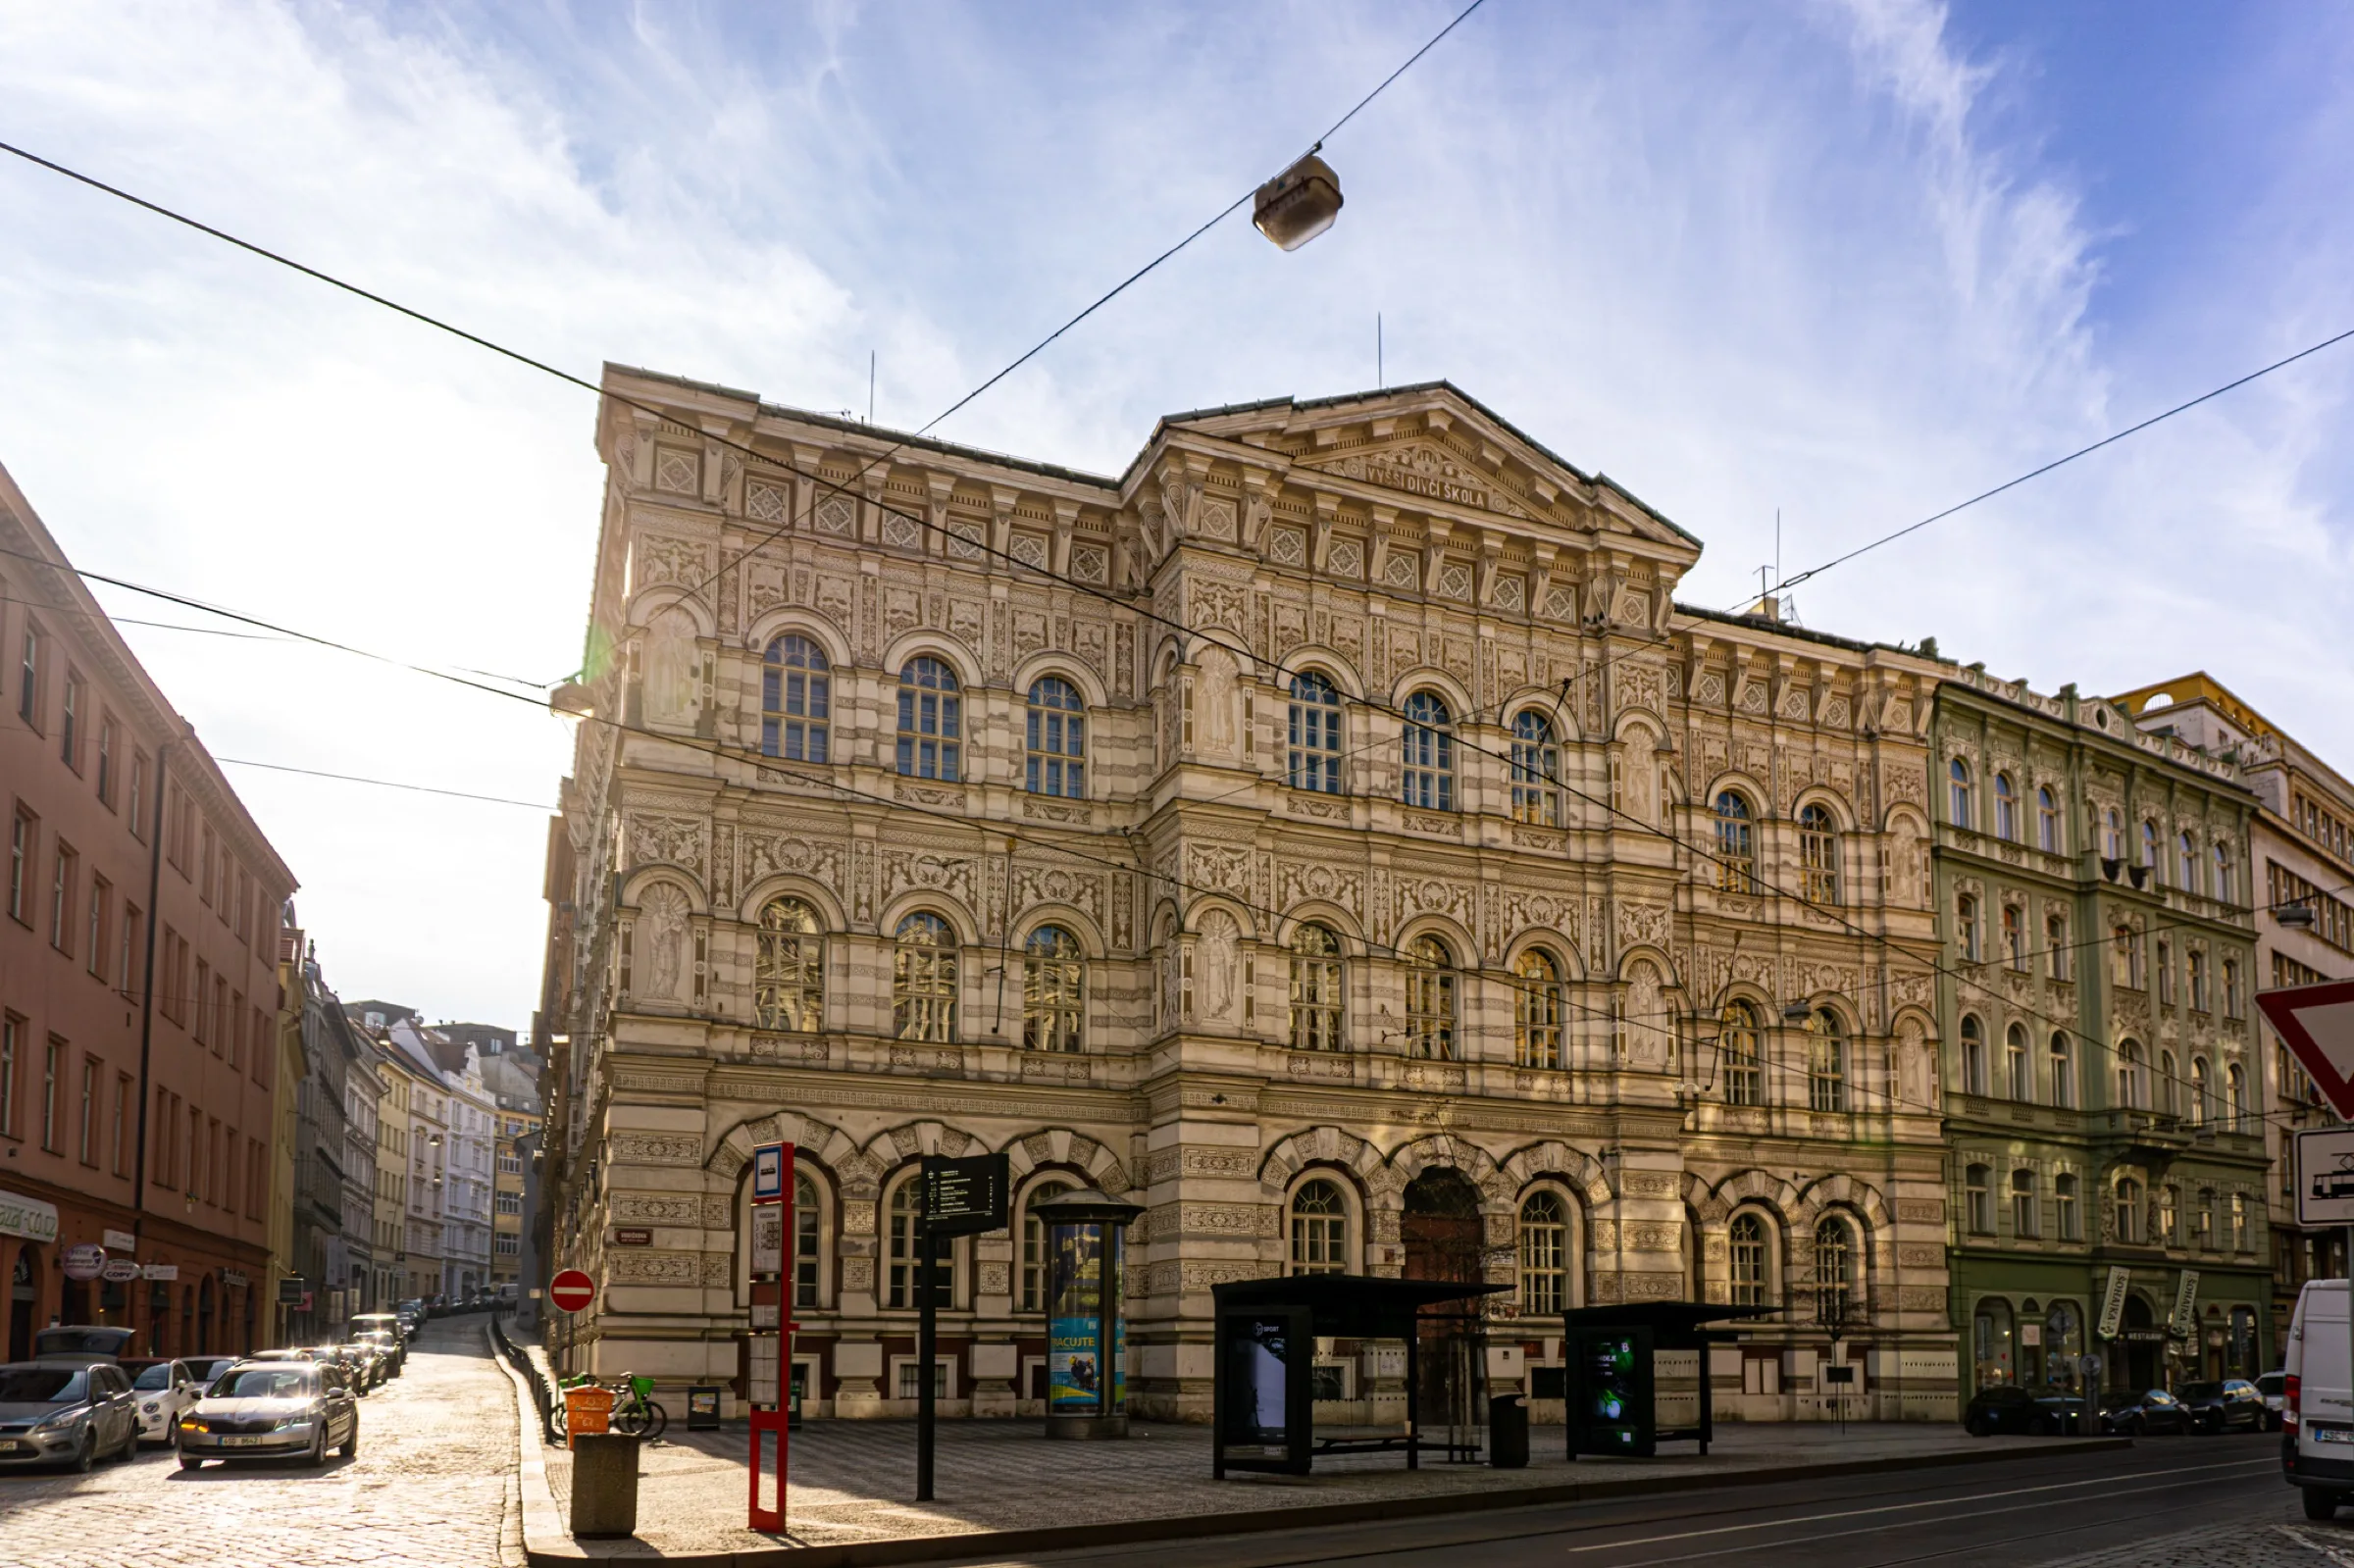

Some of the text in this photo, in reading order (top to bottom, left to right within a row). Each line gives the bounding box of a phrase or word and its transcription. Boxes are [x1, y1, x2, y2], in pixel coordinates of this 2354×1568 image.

[1367, 466, 1485, 508] VYŠŠÍ DÍVČÍ ŠKOLA
